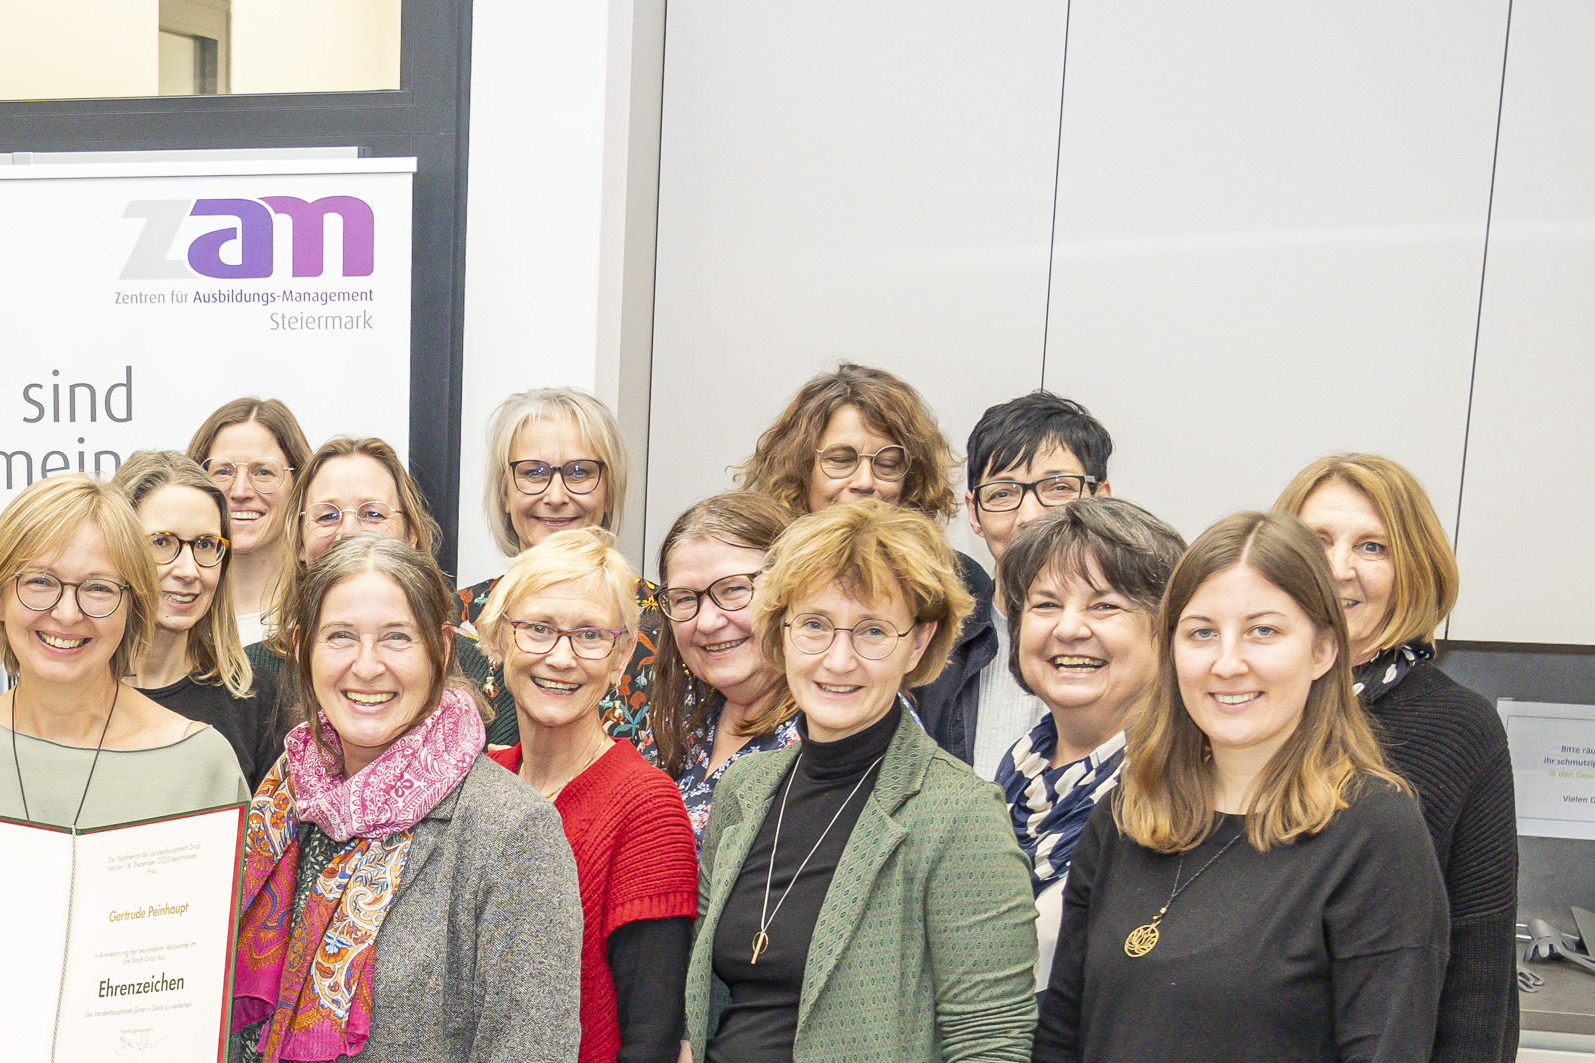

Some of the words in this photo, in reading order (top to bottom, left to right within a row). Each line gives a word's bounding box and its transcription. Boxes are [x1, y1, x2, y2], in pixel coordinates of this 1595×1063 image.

[118, 195, 375, 280] zam
[114, 291, 166, 305] Zentren
[171, 290, 189, 304] für
[193, 289, 374, 306] Ausbildungs-Management
[269, 310, 374, 331] Steiermark
[22, 365, 133, 423] sind
[1561, 746, 1580, 754] Bitte
[1558, 770, 1574, 778] den
[1563, 795, 1588, 803] Vielen
[108, 856, 116, 864] Der
[189, 843, 201, 851] Graz
[133, 860, 156, 868] Dezember
[157, 856, 170, 865] 2023
[109, 906, 146, 923] Gertrude
[148, 902, 189, 917] Peinhaupt
[131, 955, 144, 964] Stadt
[144, 954, 156, 963] Graz
[98, 971, 185, 998] Ehrenzeichen
[94, 1007, 133, 1018] Landeshauptstadt
[133, 1006, 146, 1014] Graz
[152, 1004, 164, 1012] Gold
